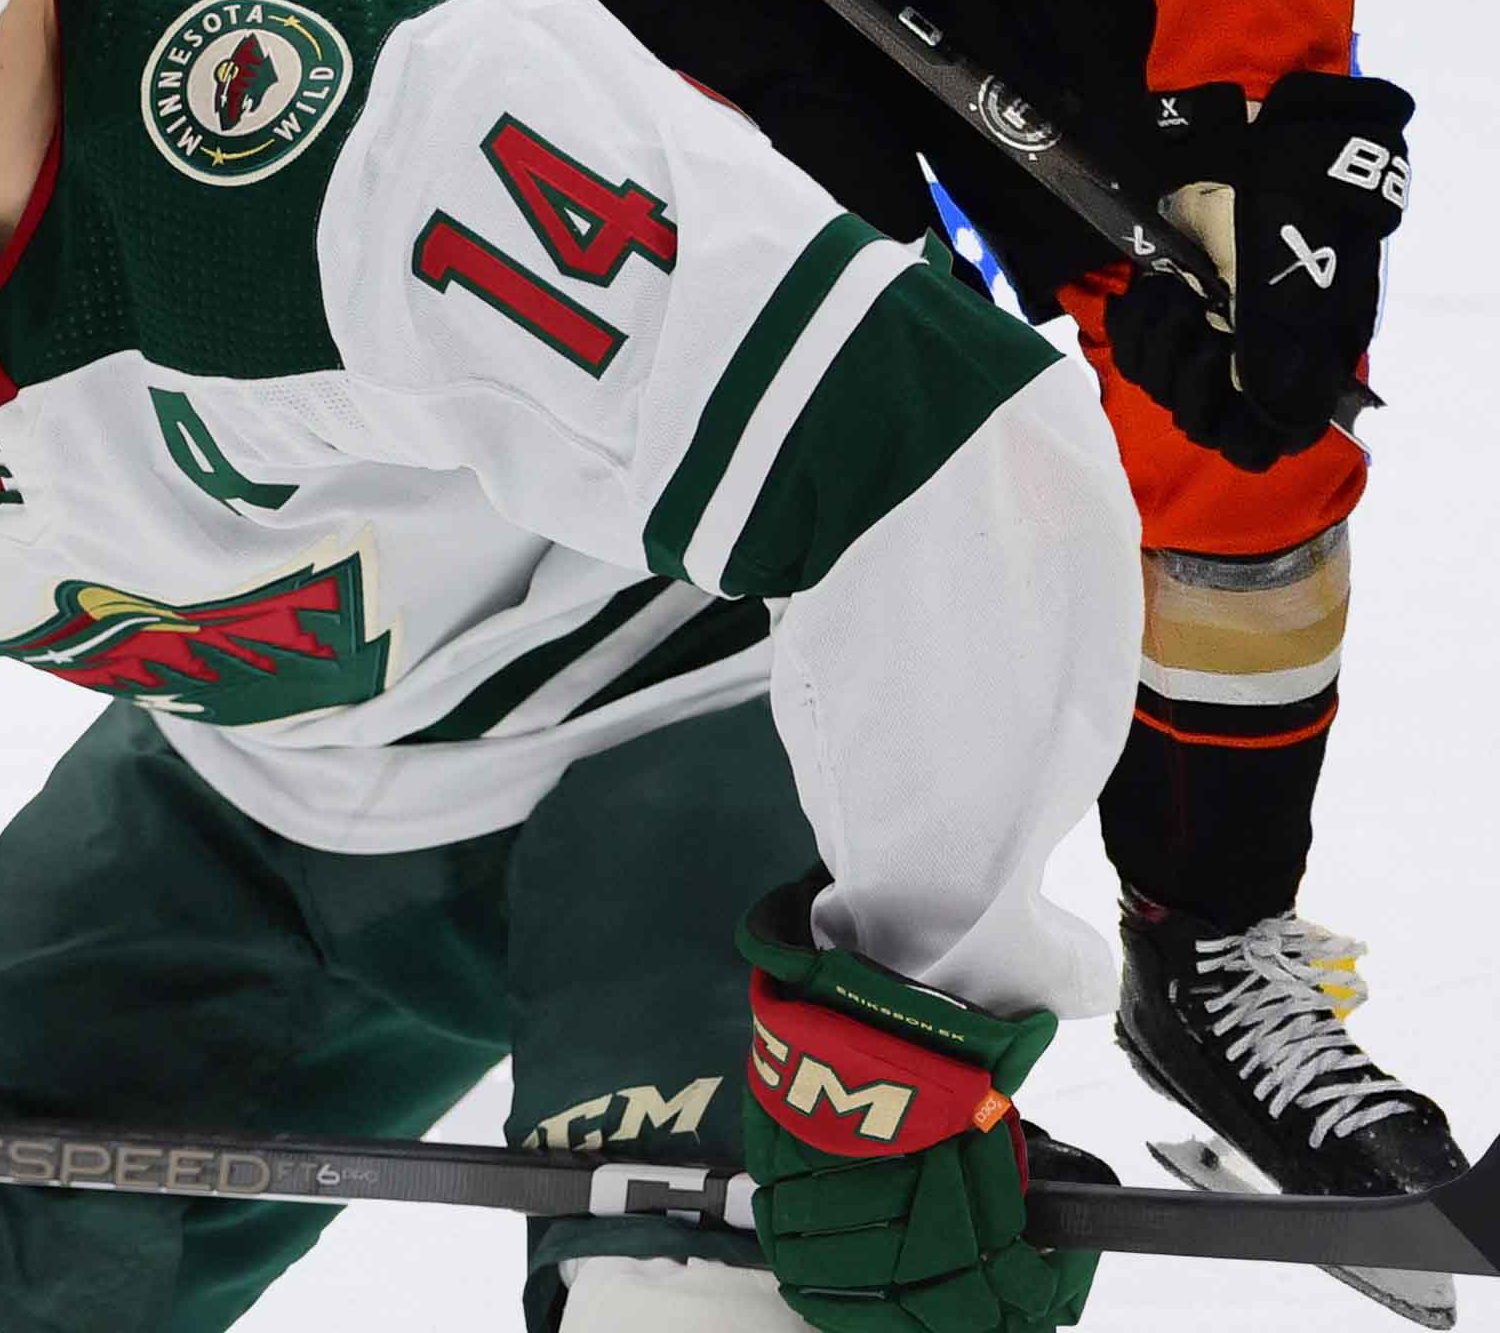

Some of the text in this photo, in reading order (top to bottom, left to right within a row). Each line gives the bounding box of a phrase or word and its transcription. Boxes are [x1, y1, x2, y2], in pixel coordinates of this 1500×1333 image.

[156, 4, 336, 157] MINNESOTA WILD
[415, 112, 678, 379] 14
[836, 984, 965, 1042] ERIKSSON EK
[522, 1076, 724, 1151] CM
